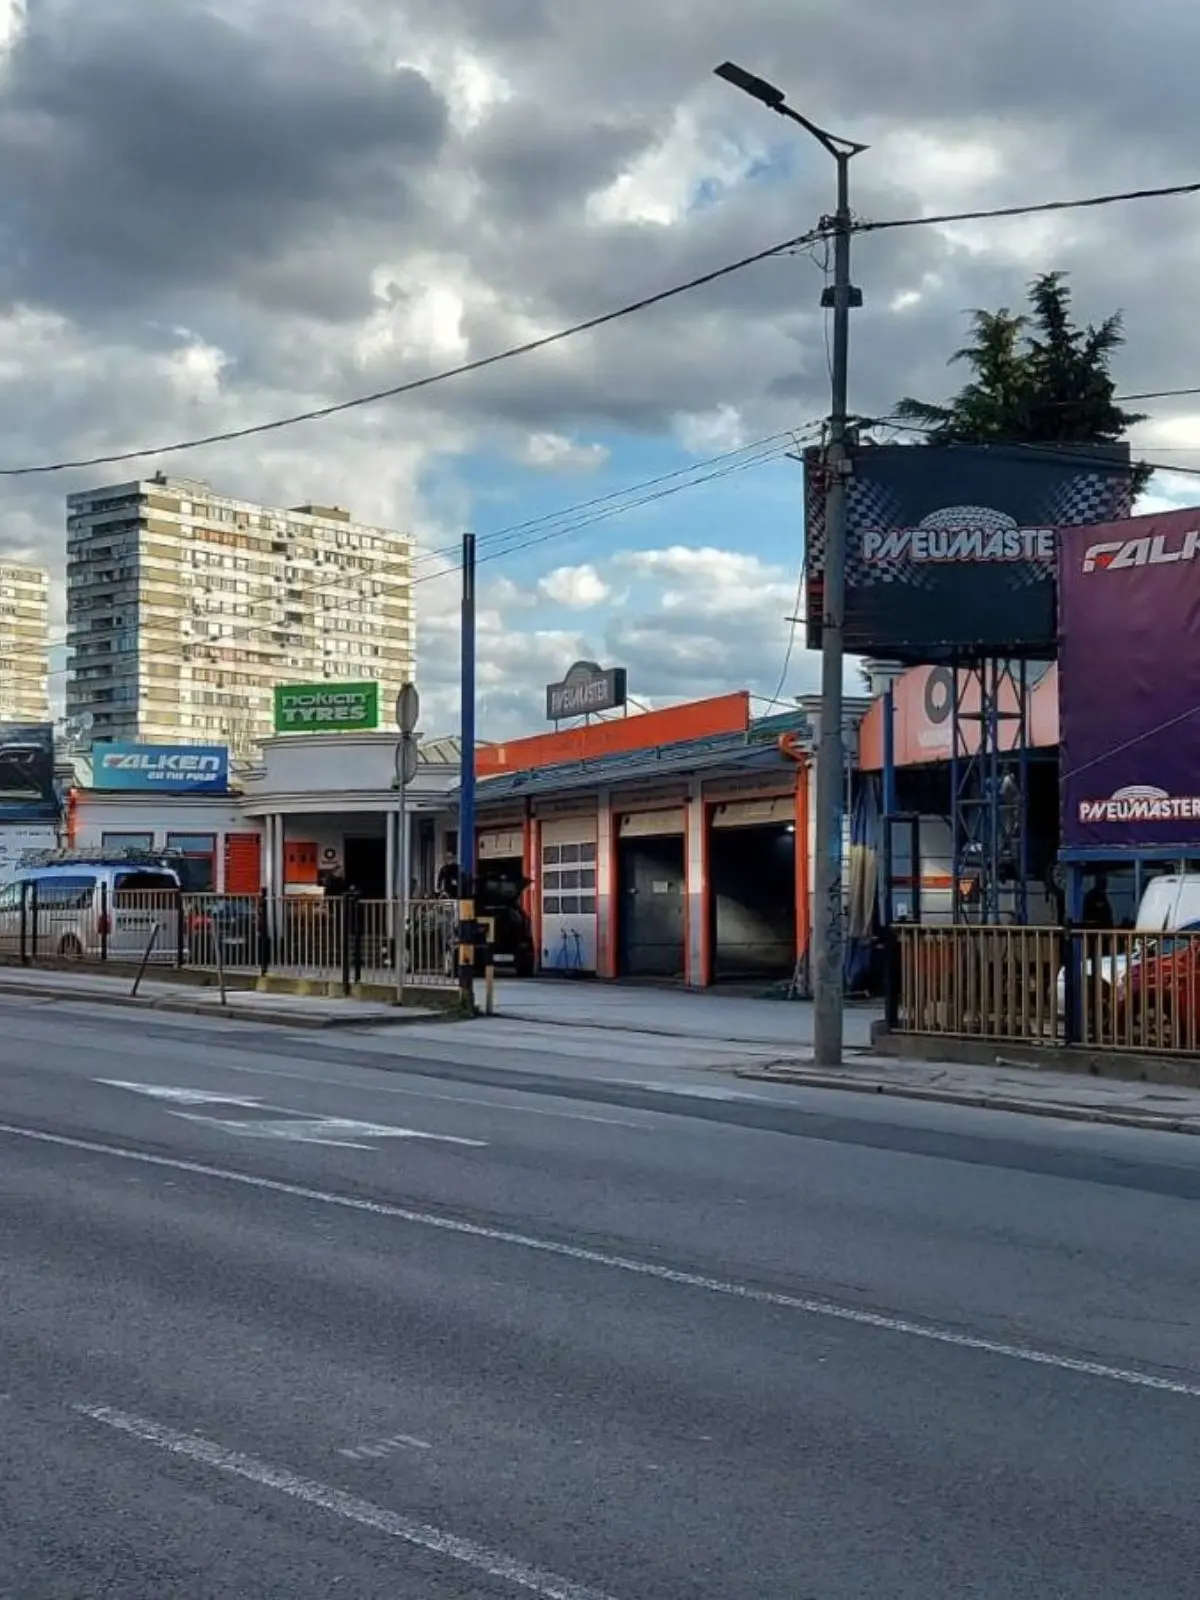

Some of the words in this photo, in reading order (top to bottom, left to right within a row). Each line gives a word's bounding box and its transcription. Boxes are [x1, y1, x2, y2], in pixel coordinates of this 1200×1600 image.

[863, 529, 1054, 559] PNEUMASTE
[282, 706, 368, 722] TYRES
[102, 753, 220, 770] FALKEN
